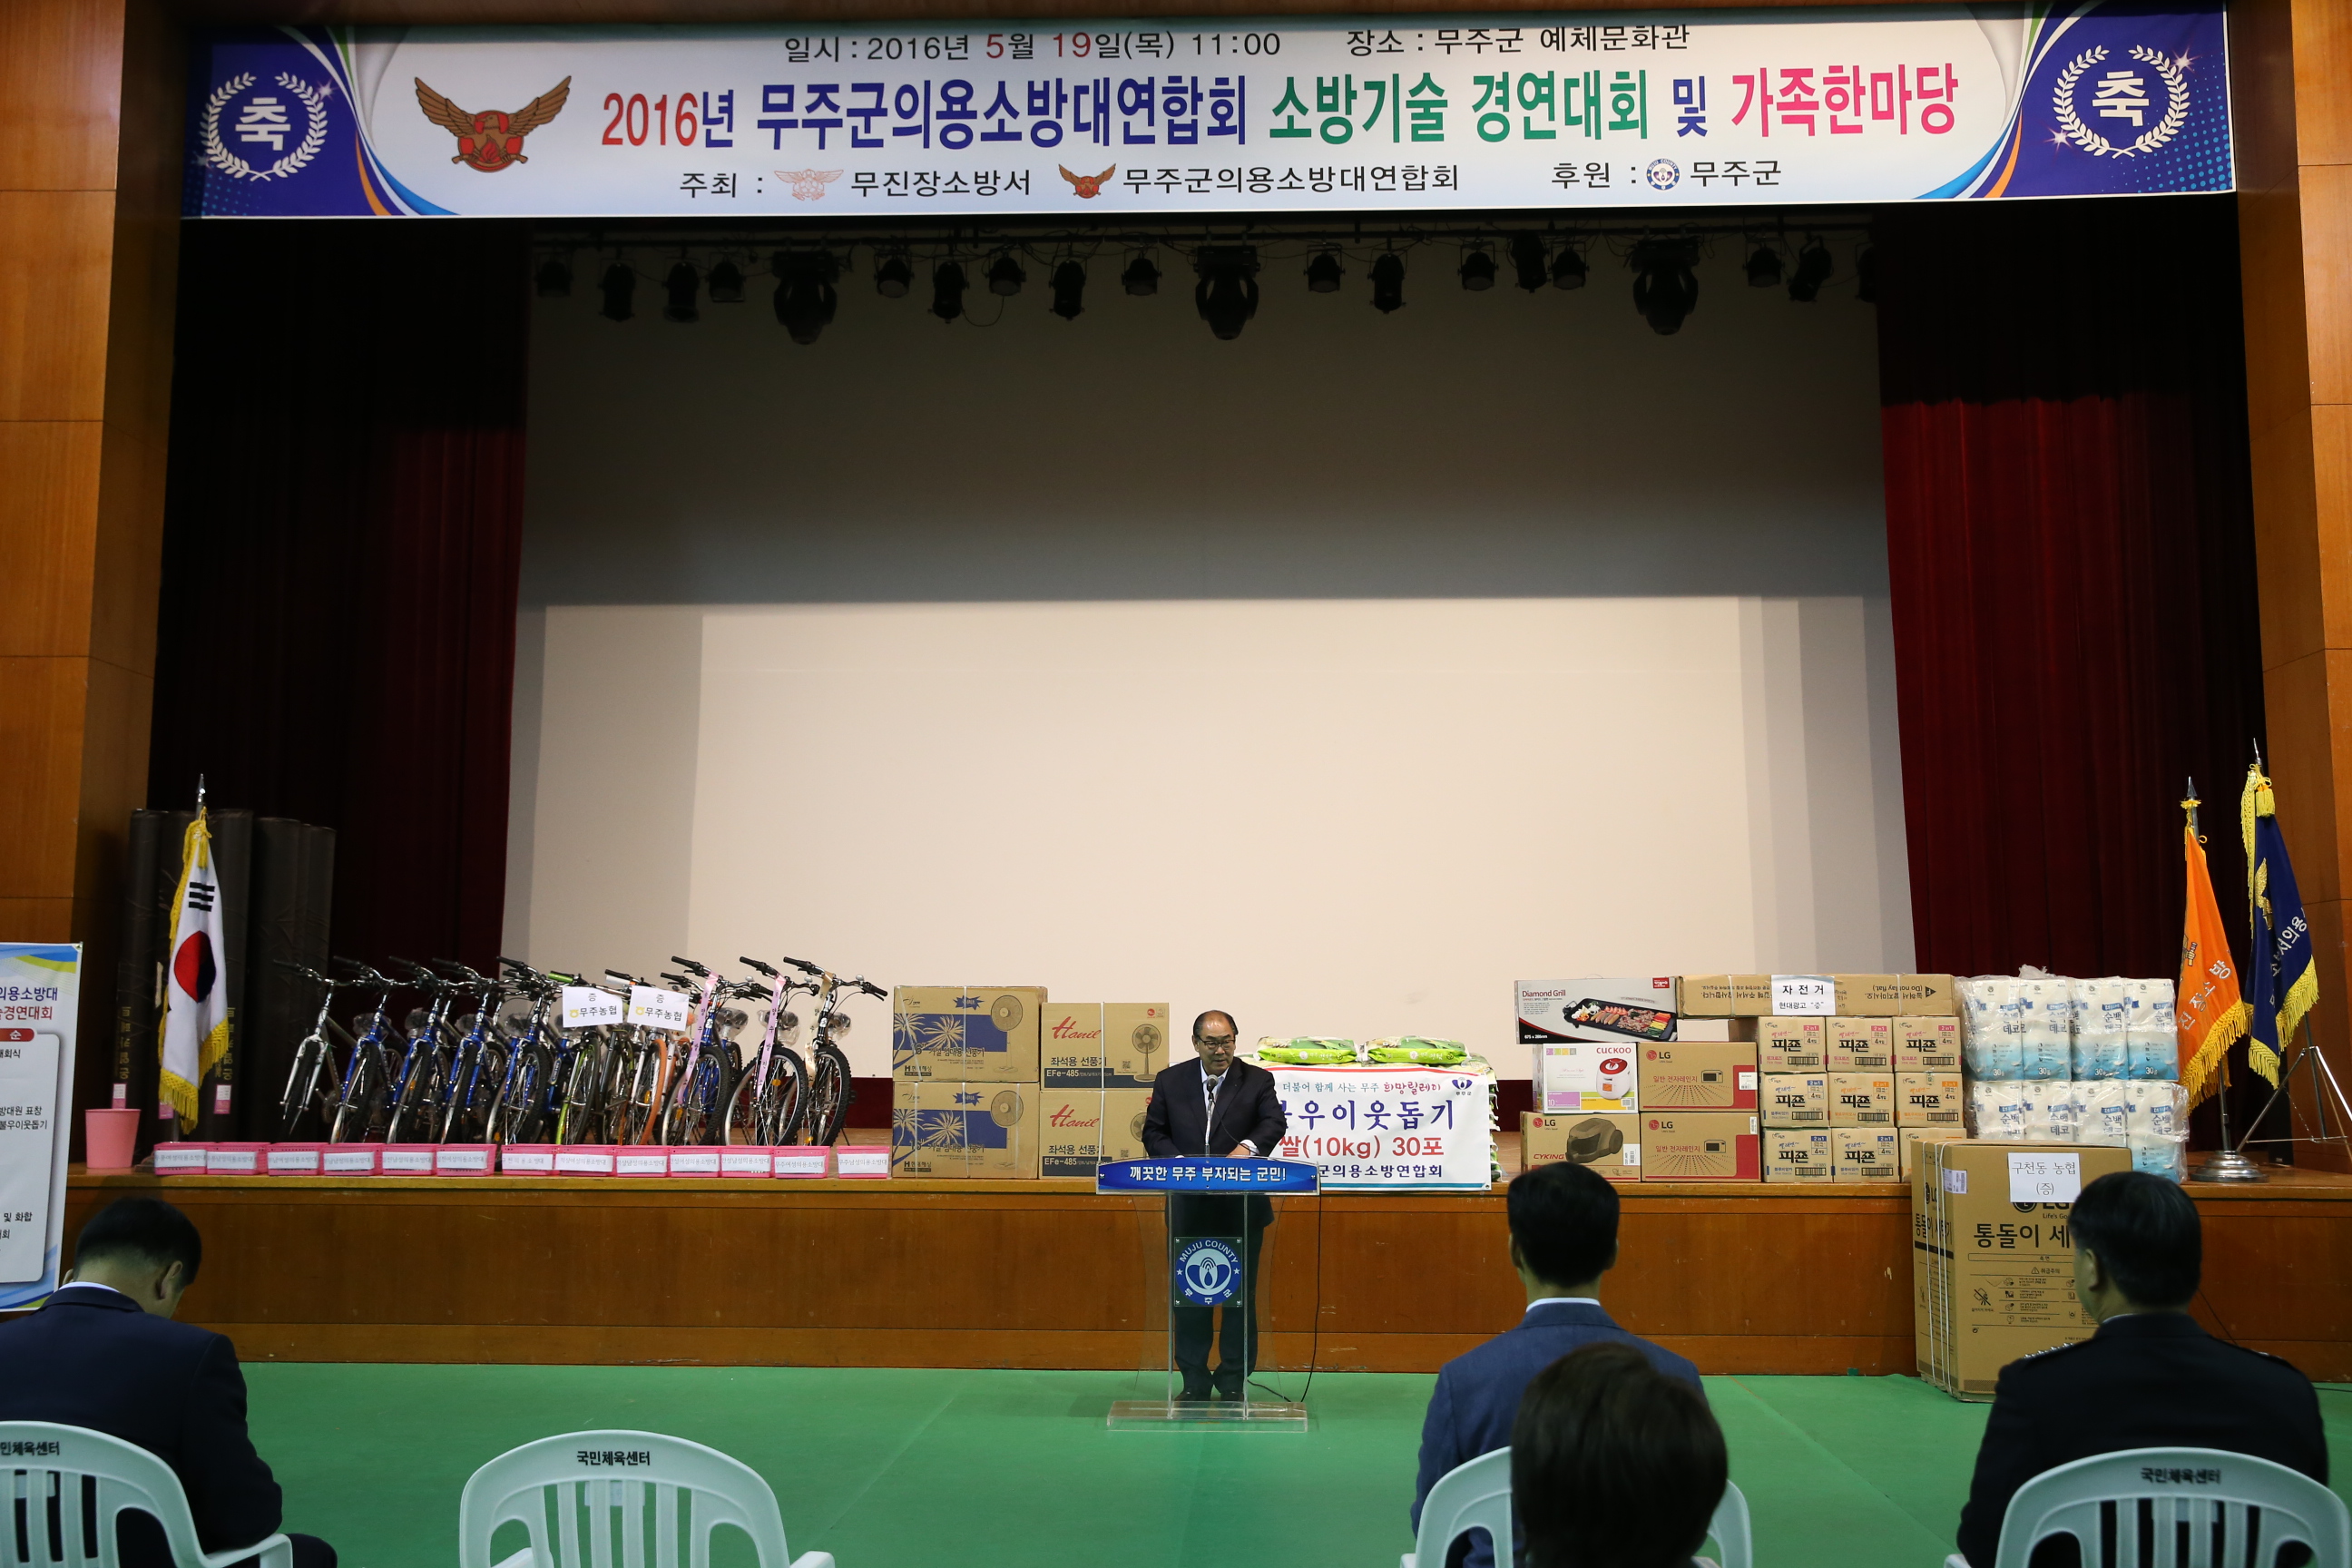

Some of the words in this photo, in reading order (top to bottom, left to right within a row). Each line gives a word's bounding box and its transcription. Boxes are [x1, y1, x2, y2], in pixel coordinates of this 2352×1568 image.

[1347, 29, 1404, 57] 장소
[1435, 27, 1522, 56] 무주군
[1540, 24, 1690, 54] 예체문화관
[785, 37, 841, 64] 일시
[867, 34, 970, 63] 2016년
[985, 33, 1034, 60] 5월
[1053, 32, 1176, 61] 19일(목)
[1192, 33, 1281, 57] 11:00
[2091, 69, 2150, 127] 축
[602, 89, 734, 150] 2016년
[757, 74, 1247, 150] 무주군의용소방대연합회
[1269, 71, 1449, 146] 소방기술
[1471, 68, 1648, 143] 경연대회
[1672, 75, 1709, 138] 및
[1730, 63, 1959, 138] 가족한마당
[235, 95, 292, 152] 축
[1122, 164, 1459, 195] 무주군의용소방대연합회
[1551, 162, 1612, 190] 후원
[1690, 161, 1782, 187] 무주군
[679, 172, 737, 198] 주최
[850, 169, 1031, 198] 무진장소방서
[579, 1005, 617, 1016] 무주농협
[1779, 1001, 1807, 1009] 현대광고
[0, 1005, 53, 1021] 경연대회
[645, 1006, 682, 1022] 무주농협
[1052, 1016, 1102, 1039] Hanil
[2003, 1024, 2021, 1034] 데코
[9, 1030, 22, 1041] 순
[1771, 1039, 1801, 1052] 피죤
[1839, 1039, 1869, 1052] 피죤
[1906, 1039, 1936, 1052] 피죤
[1051, 1057, 1077, 1066] 좌석용
[1283, 1083, 1310, 1093] 더불어
[1315, 1082, 1333, 1093] 함께
[1338, 1083, 1356, 1093] 사는
[1360, 1083, 1379, 1093] 무주
[1384, 1082, 1441, 1095] 희망릴레이
[1776, 1094, 1805, 1107] 피죤
[1840, 1095, 1870, 1108] 피죤
[1910, 1095, 1939, 1108] 피죤
[25, 1106, 43, 1115] 표창
[1050, 1104, 1100, 1127] Hanil
[2051, 1125, 2070, 1136] 데코
[1049, 1145, 1075, 1154] 좌석용
[1279, 1135, 1380, 1159] 쌀(10kg)
[1392, 1137, 1445, 1156] 30포
[1779, 1151, 1808, 1163] 피죤
[1845, 1151, 1876, 1163] 피죤
[1130, 1166, 1168, 1181] 깨끗한
[1172, 1166, 1196, 1181] 무주
[1202, 1167, 1251, 1181] 부자되는
[1257, 1167, 1287, 1181] 군민!
[2012, 1162, 2047, 1175] 구천동
[2053, 1161, 2076, 1175] 농협
[2036, 1182, 2054, 1195] (증)
[4, 1212, 13, 1222] 및
[15, 1212, 33, 1222] 화합
[1974, 1223, 2040, 1249] 통돌이
[1180, 1241, 1203, 1262] MUJU
[1205, 1240, 1239, 1263] COUNTY
[576, 1450, 651, 1465] 국민체육센터
[2141, 1467, 2221, 1484] 국민체육센터
